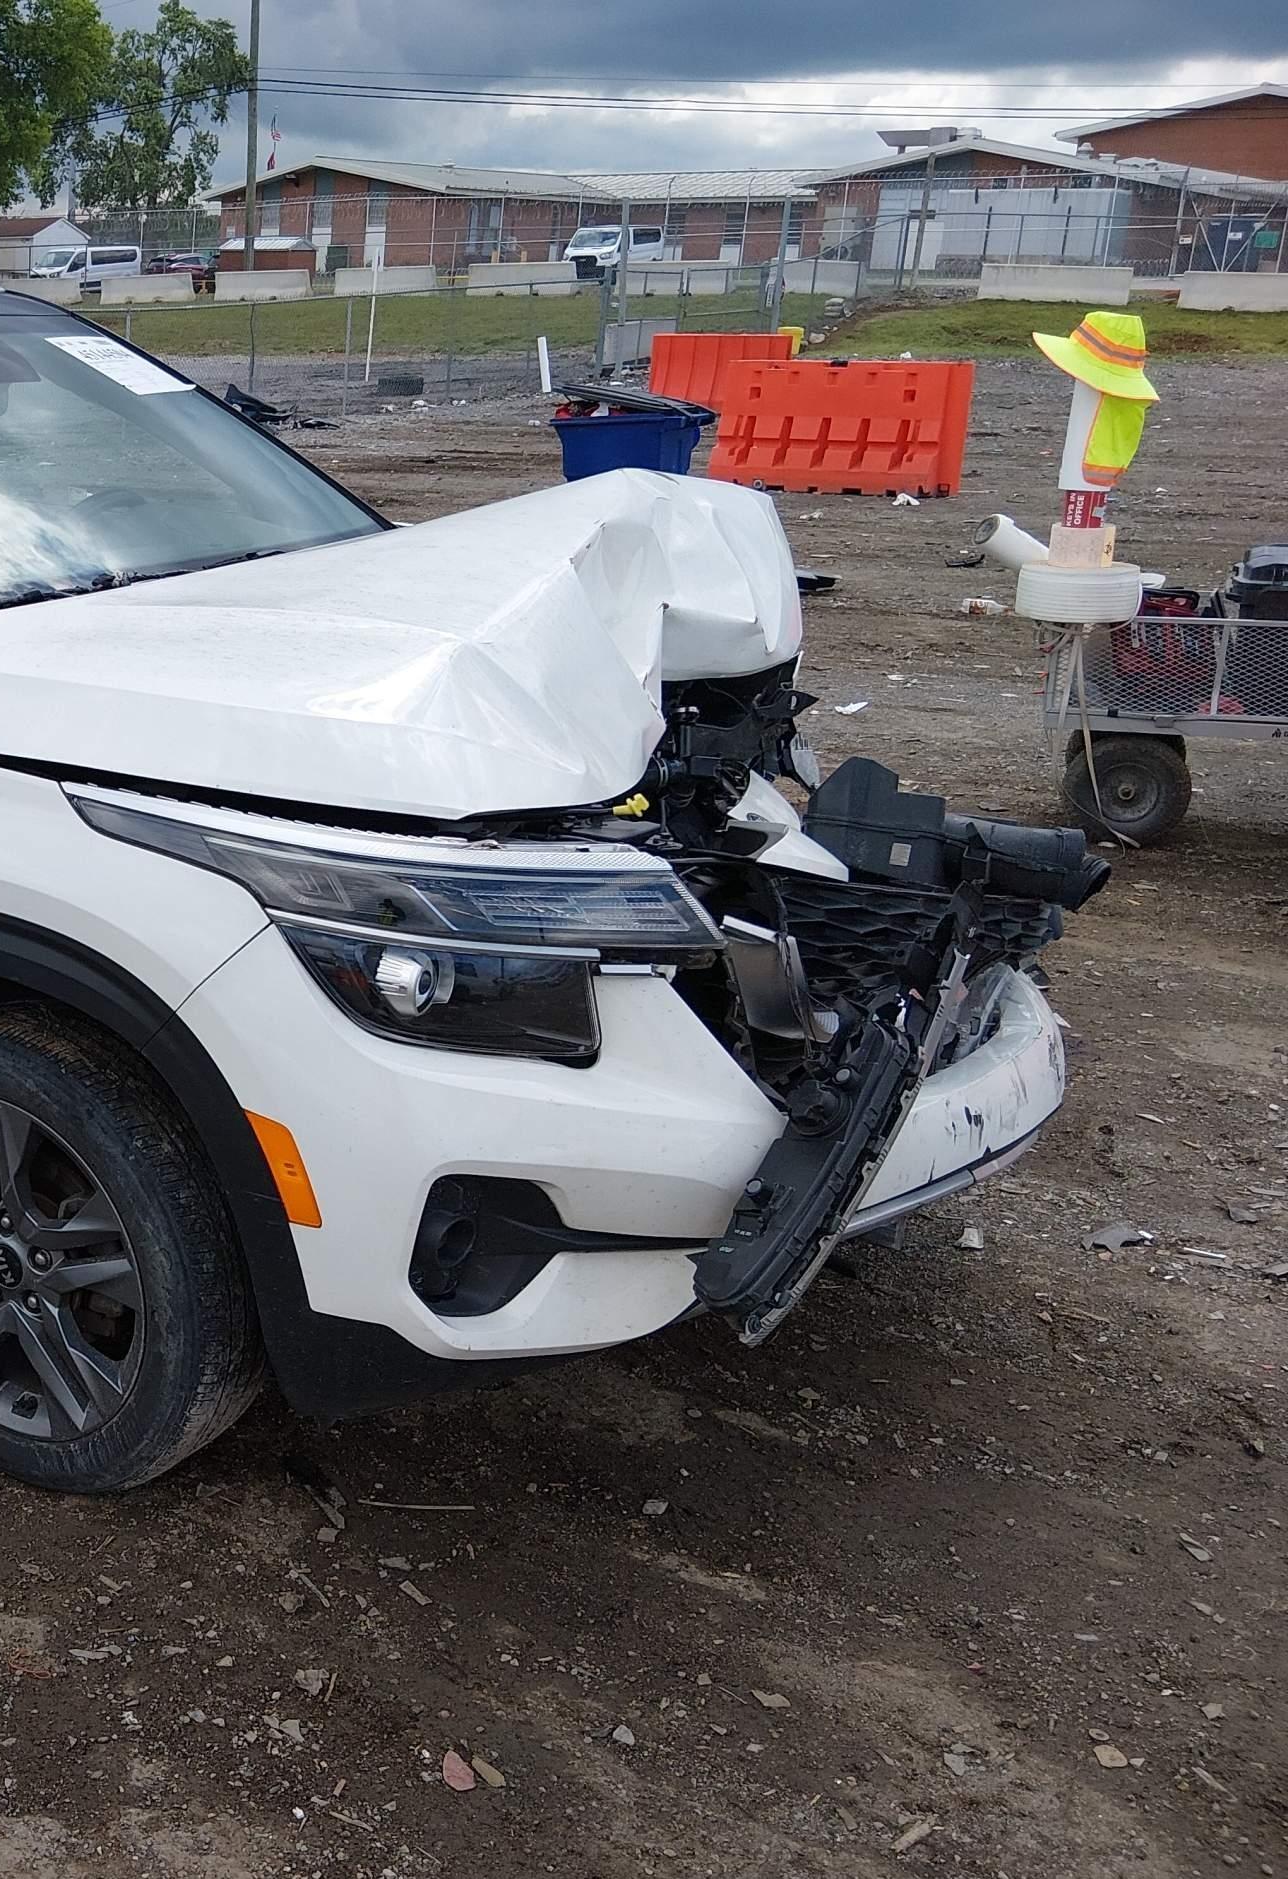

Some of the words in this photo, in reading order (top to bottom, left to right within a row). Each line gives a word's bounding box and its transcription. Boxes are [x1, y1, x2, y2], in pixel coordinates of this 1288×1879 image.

[1070, 493, 1076, 502] IN
[1066, 504, 1075, 526] KEYS
[1074, 495, 1085, 525] OFFICE
